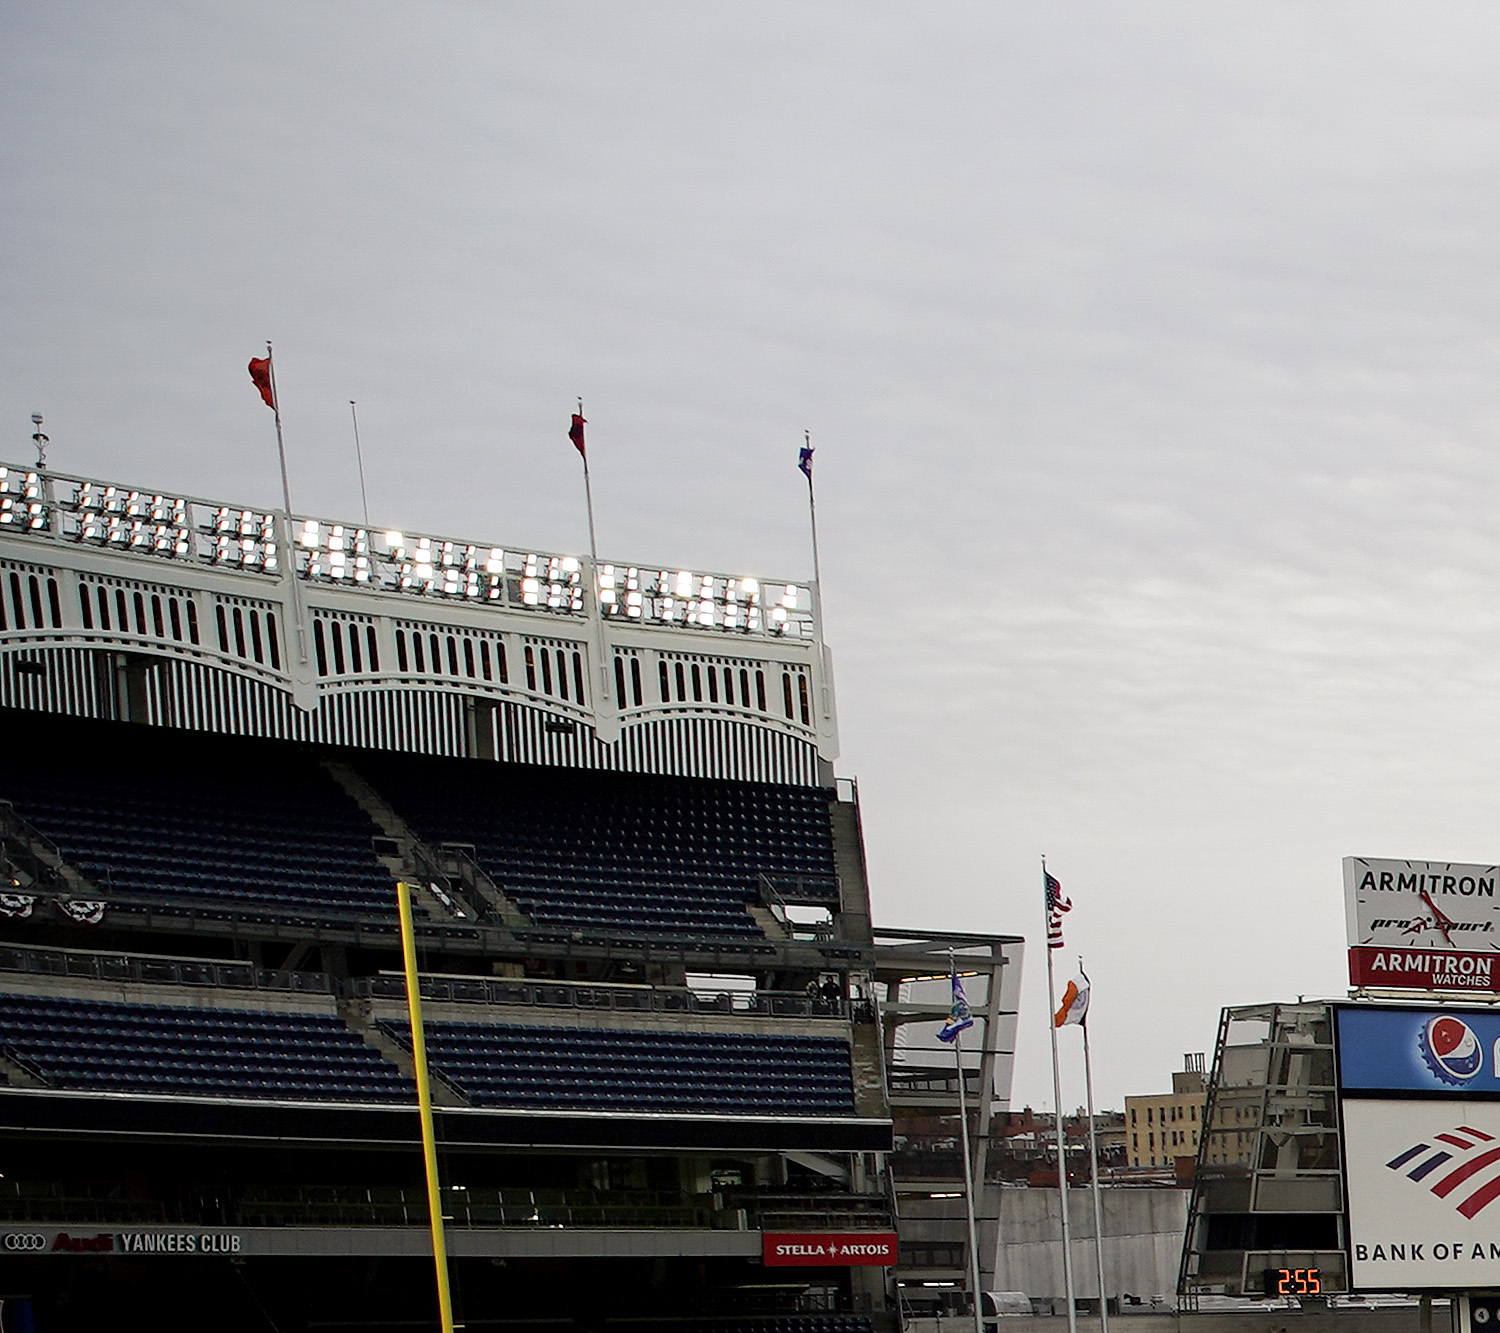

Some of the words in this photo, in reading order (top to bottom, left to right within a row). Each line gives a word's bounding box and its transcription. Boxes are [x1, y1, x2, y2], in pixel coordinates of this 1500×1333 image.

[1360, 872, 1494, 896] ARMITRON
[1371, 953, 1493, 975] ARMITRON
[1432, 973, 1491, 987] WATCHES
[52, 1233, 114, 1251] Audi
[122, 1233, 196, 1252] YANKEES
[201, 1235, 241, 1252] CLUB
[776, 1244, 825, 1255] STELLA
[840, 1244, 890, 1255] ARTOIS
[1356, 1243, 1425, 1262] BANK
[1432, 1243, 1465, 1262] OF
[1278, 1268, 1320, 1294] 2:55
